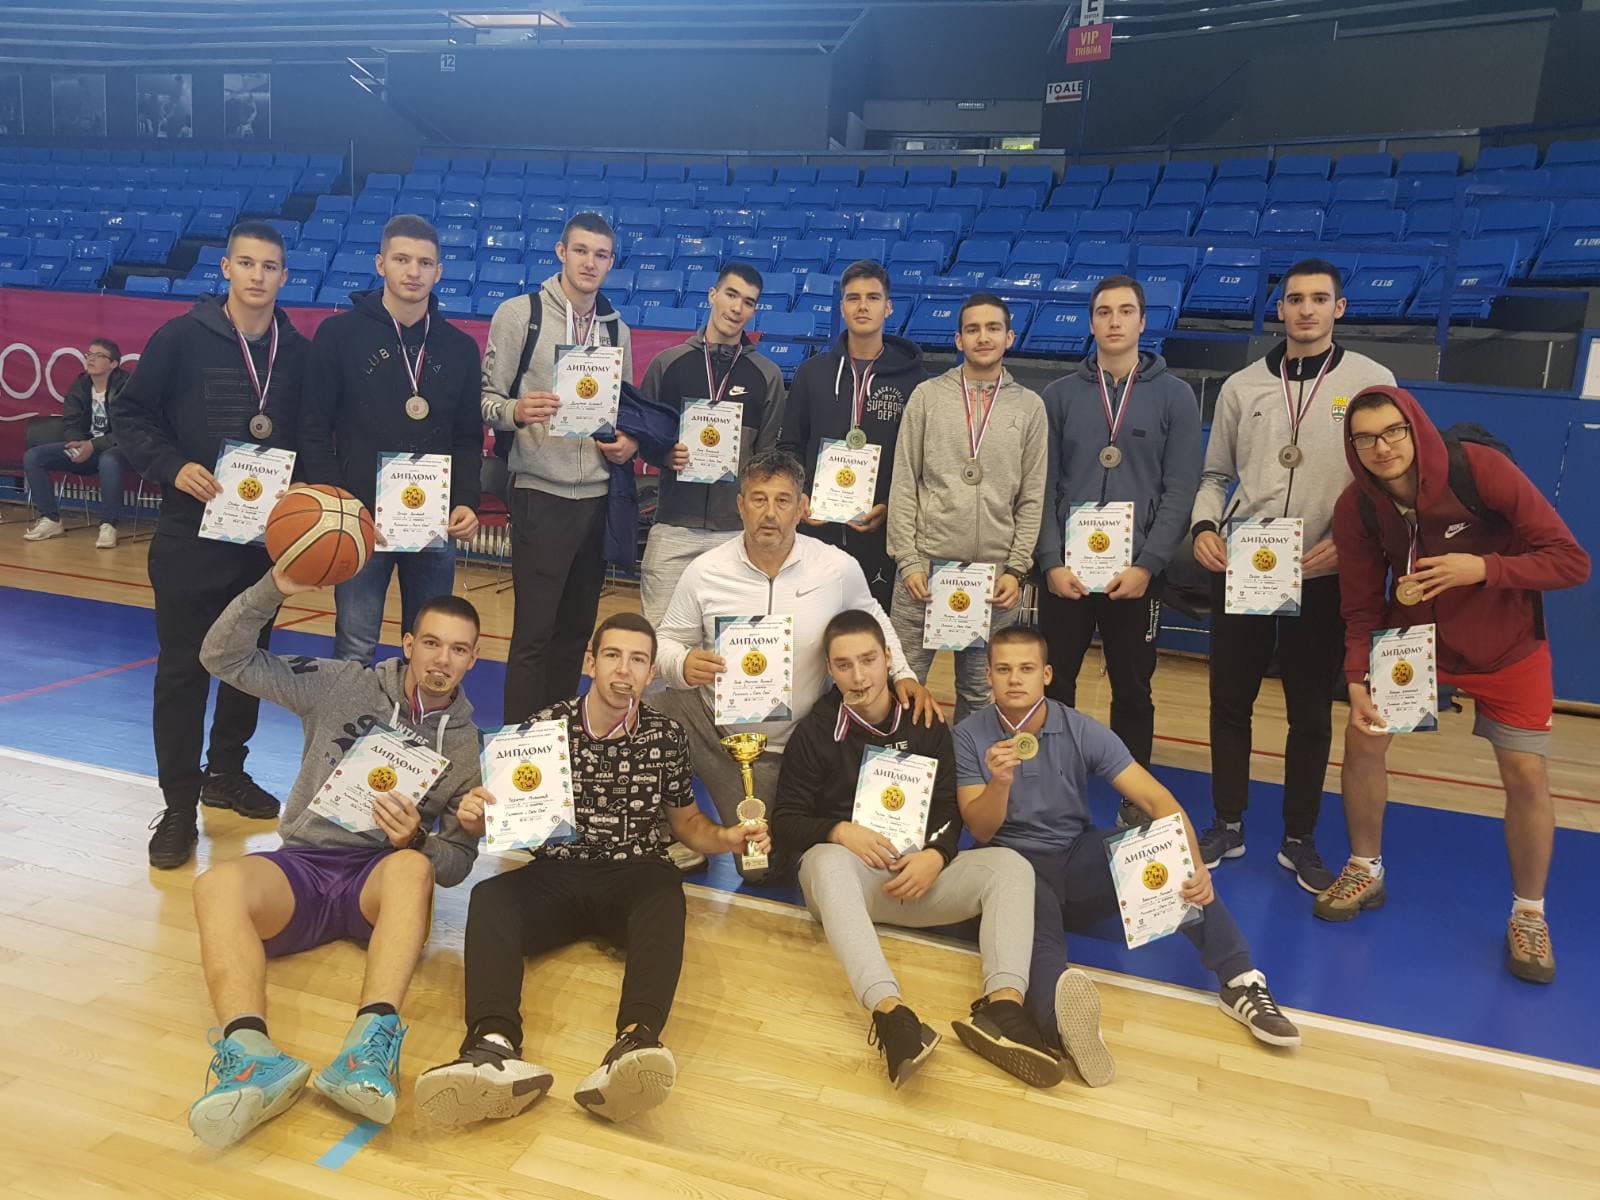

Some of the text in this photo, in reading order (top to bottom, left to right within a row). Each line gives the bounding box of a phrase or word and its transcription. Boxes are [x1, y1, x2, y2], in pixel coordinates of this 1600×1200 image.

[1081, 31, 1099, 45] VIP
[1075, 45, 1102, 57] TRIBINA
[443, 55, 455, 68] 12
[566, 363, 611, 373] ДИПЛОМУ
[230, 461, 280, 477] ДИПЛОМУ
[390, 472, 438, 481] ДИПЛОМУ
[1240, 536, 1290, 544] ДИПЛОМУ
[940, 579, 982, 587] ДИПЛОМУ
[729, 637, 780, 646] ДИПЛОМУ
[1381, 646, 1424, 658] ДИПЛОМУ
[496, 745, 553, 759] ДИПЛОМУ
[370, 744, 425, 777] ДИПЛОМУ
[873, 768, 921, 785] ДИПЛОМУ
[1124, 840, 1173, 865] ДИПЛОМУ
